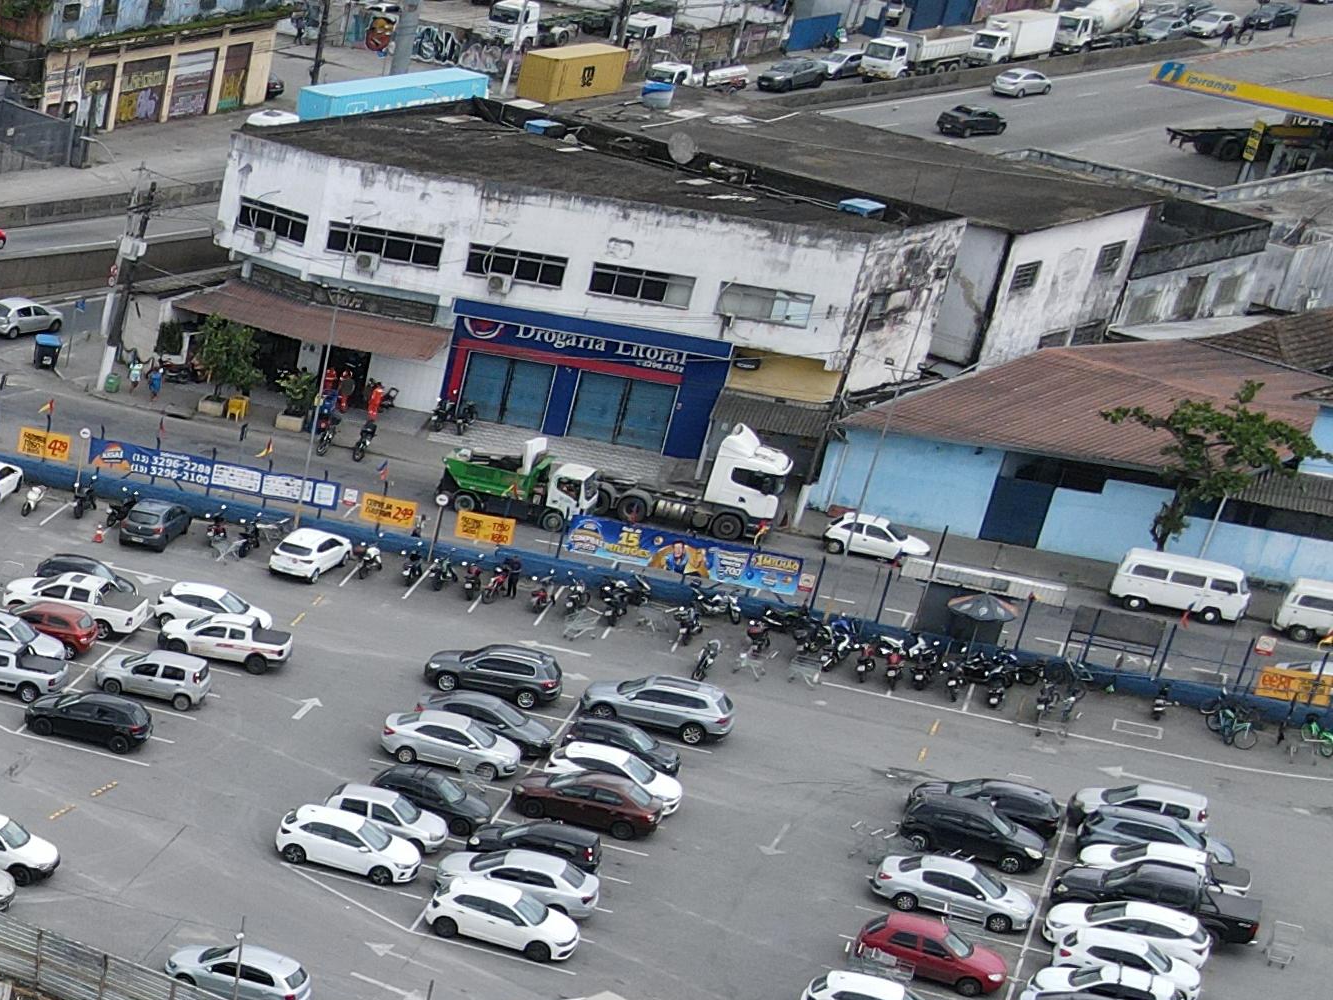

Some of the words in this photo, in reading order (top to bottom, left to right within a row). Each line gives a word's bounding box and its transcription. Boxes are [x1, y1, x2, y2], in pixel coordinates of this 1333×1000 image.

[515, 324, 606, 352] Drogaria
[614, 340, 687, 366] Litoral
[150, 466, 209, 484] 3296-2100
[619, 531, 640, 546] 15
